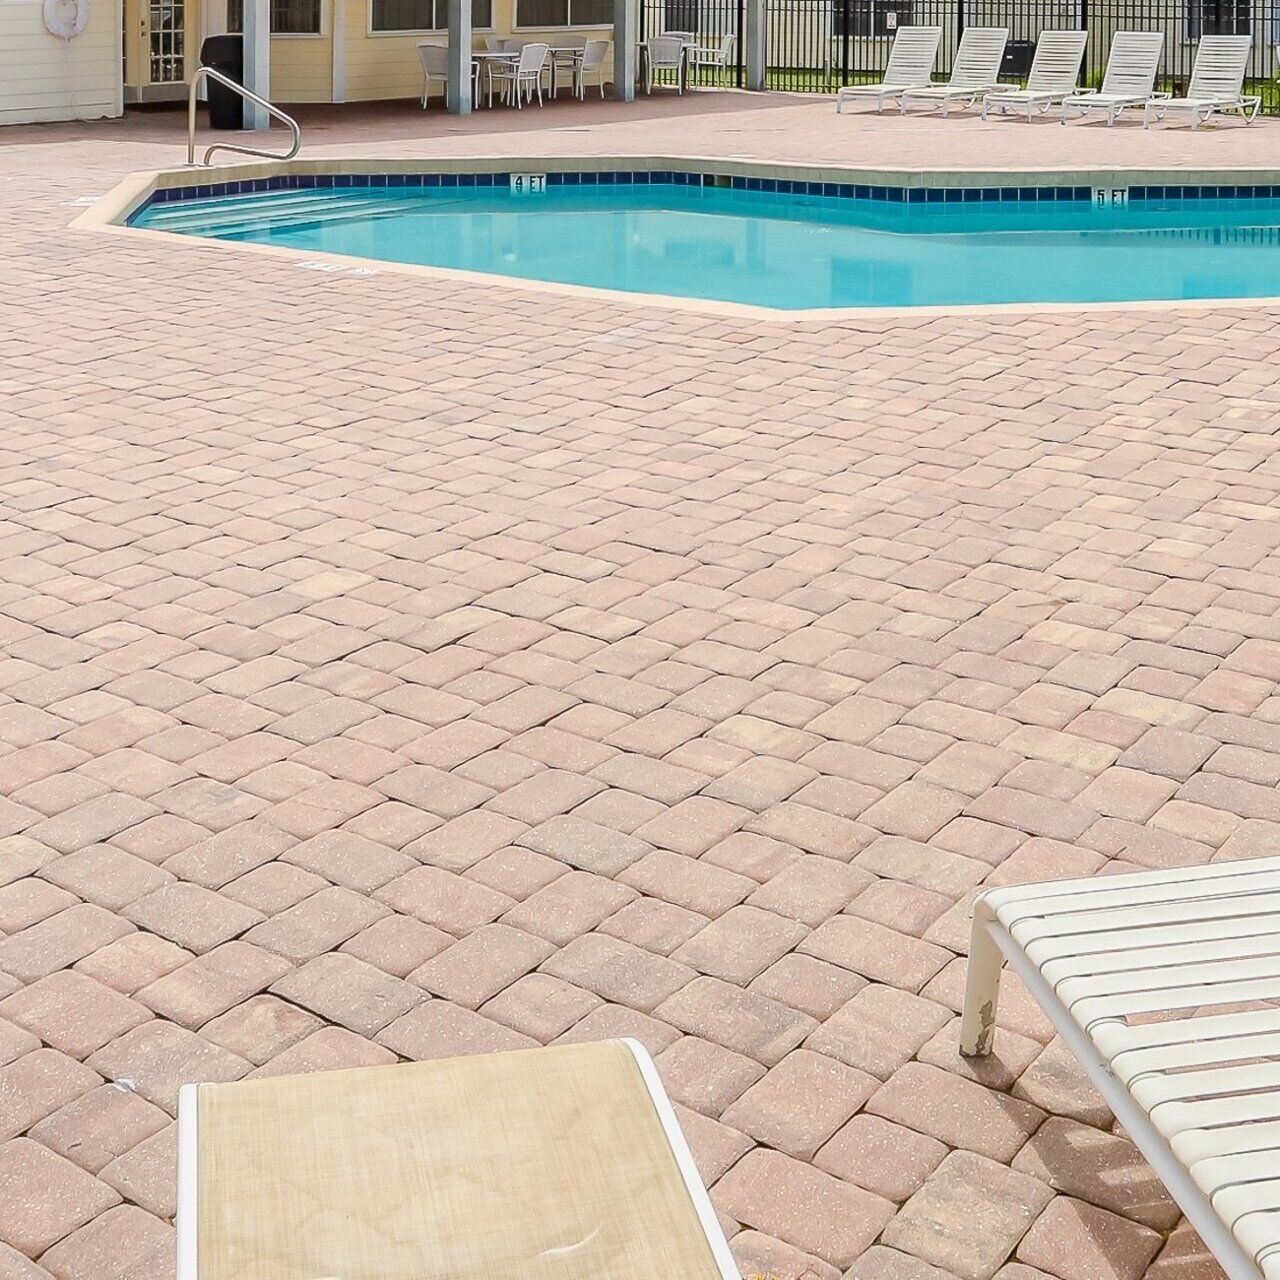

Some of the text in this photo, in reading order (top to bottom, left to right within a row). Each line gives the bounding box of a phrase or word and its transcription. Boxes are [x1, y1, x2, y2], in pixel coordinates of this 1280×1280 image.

[515, 176, 544, 186] 4 FT
[1112, 189, 1126, 201] FT
